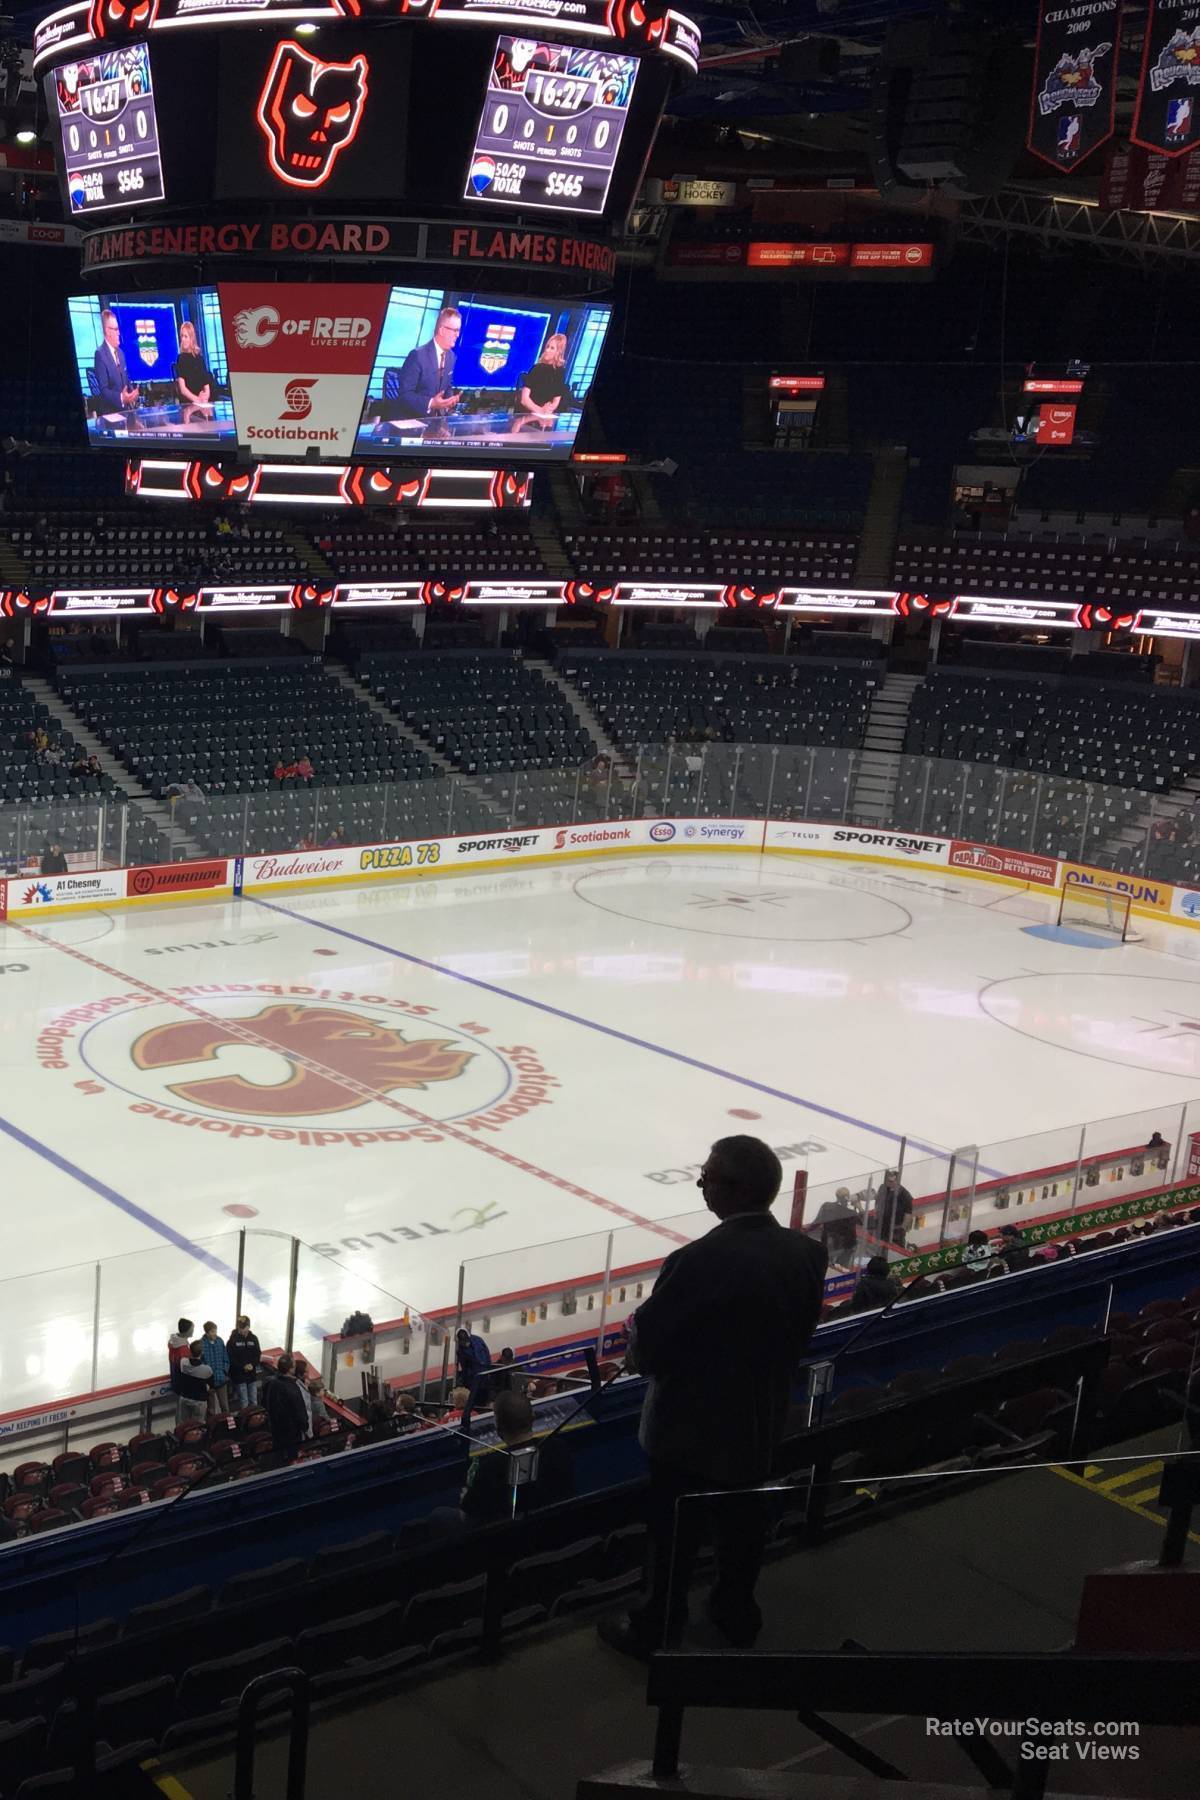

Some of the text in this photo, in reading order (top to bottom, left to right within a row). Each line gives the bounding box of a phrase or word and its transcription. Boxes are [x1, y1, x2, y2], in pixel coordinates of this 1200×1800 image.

[1045, 0, 1117, 23] CHAMPIONS
[1066, 20, 1091, 35] 2009
[84, 84, 121, 117] 16:27
[533, 76, 590, 110] 16:27
[69, 125, 80, 152] 0
[90, 129, 97, 148] 0
[118, 123, 126, 142] 0
[137, 110, 147, 139] 0
[493, 105, 609, 149] 0 0 1 0 0
[513, 140, 534, 152] SHOTS
[561, 147, 582, 158] SHOTS
[83, 173, 103, 188] 50/50
[117, 168, 144, 193] $565
[496, 162, 526, 179] 50/50
[493, 177, 521, 194] TOTAL
[545, 172, 584, 197] $565
[684, 189, 726, 200] HOCKEY
[32, 229, 61, 241] CO-OP
[88, 222, 391, 263] FLAMES ENERGY BOARD
[452, 228, 556, 263] FLAMES
[282, 317, 372, 339] OF RED
[343, 339, 367, 347] HERE
[246, 426, 340, 441] Scotiabank
[570, 828, 631, 844] Scotiabank
[653, 826, 672, 837] Esso
[700, 826, 745, 839] Synergy
[457, 834, 540, 853] SPORTSNET
[833, 830, 946, 854] SPORTSNET
[360, 843, 441, 870] PIZZA 73
[156, 869, 222, 885] WARRIOR
[252, 858, 343, 880] Budweiser
[1004, 863, 1029, 874] BETTER
[56, 879, 102, 890] A1 Chesney
[1066, 871, 1159, 903] ON RUN
[453, 1045, 562, 1132] Scotiabank
[128, 1102, 446, 1147] Saddledome
[310, 1221, 452, 1260] TELUS
[16, 1417, 42, 1429] KEEPING
[43, 1416, 49, 1425] IT
[49, 1412, 68, 1424] FRESH
